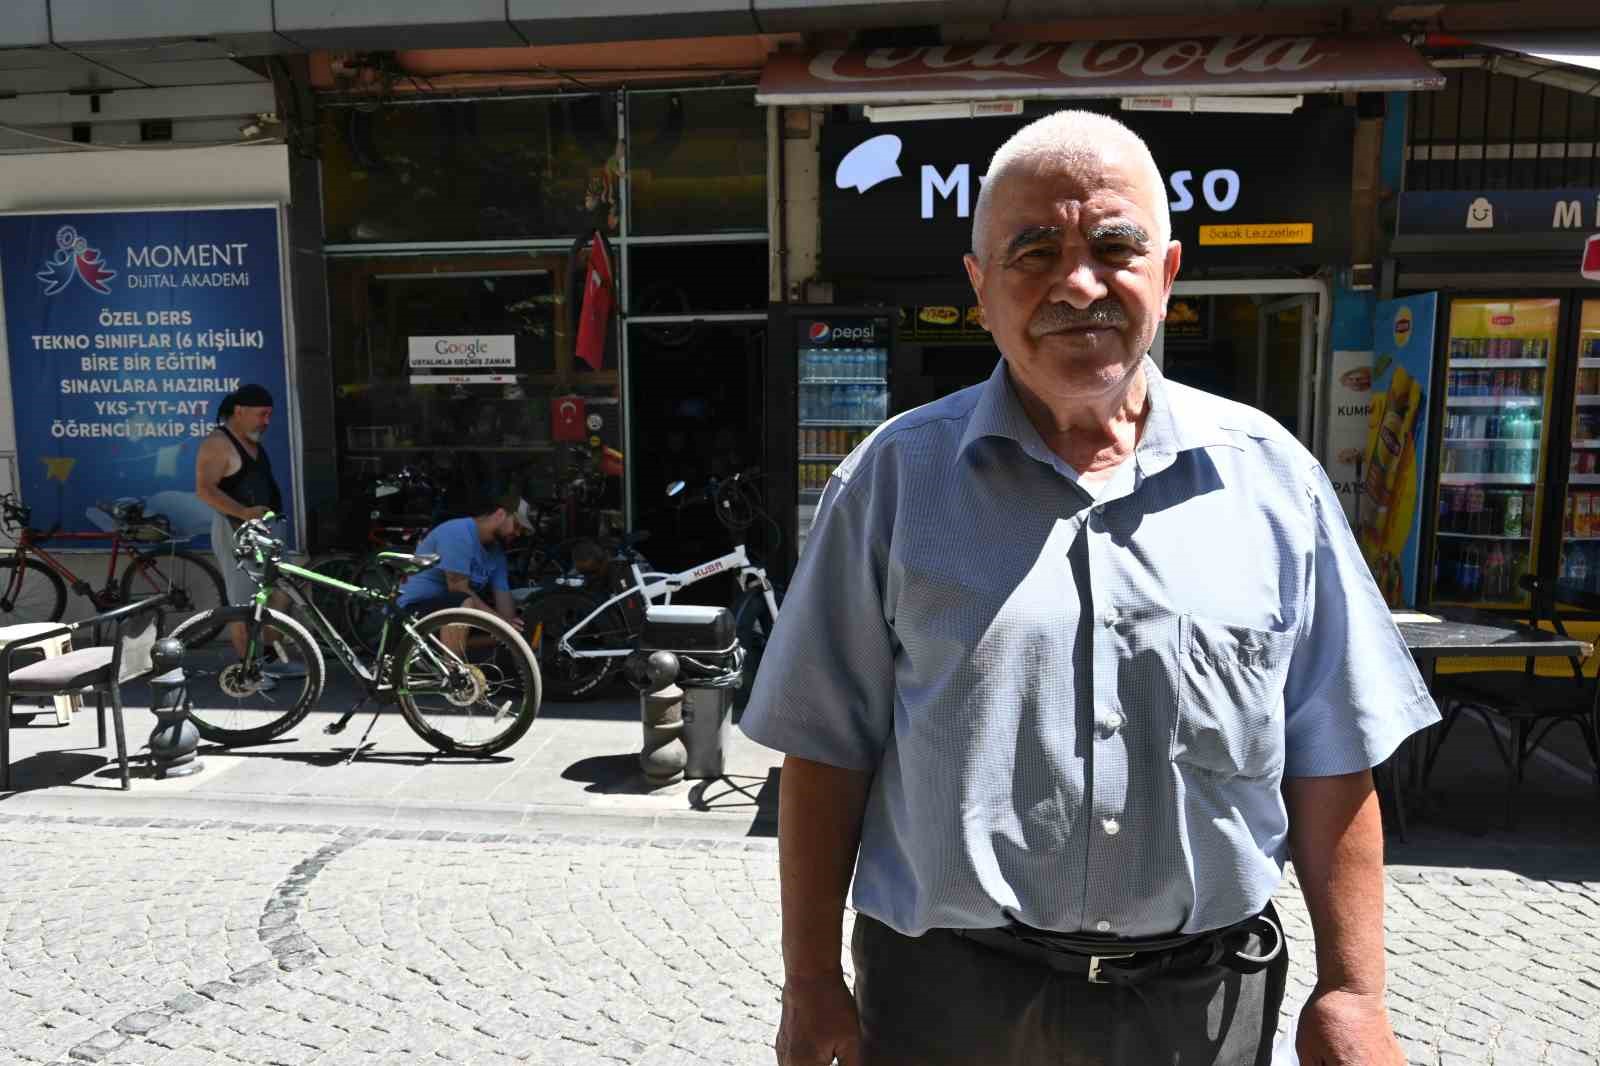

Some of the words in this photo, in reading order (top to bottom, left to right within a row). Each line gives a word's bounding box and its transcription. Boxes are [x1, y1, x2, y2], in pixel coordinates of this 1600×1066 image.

[127, 243, 249, 268] MOMENT
[98, 308, 143, 327] ÖZEL
[146, 310, 192, 325] DERS
[32, 335, 90, 350] TEKNO
[95, 333, 171, 349] SINIFLAR
[176, 332, 191, 349] (6
[197, 329, 265, 349] KİŞİLİK)
[832, 323, 875, 341] pepsi
[435, 338, 488, 358] Google
[81, 353, 119, 371] BİRE
[124, 352, 151, 371] BİR
[156, 351, 217, 371] EĞİTİM
[60, 378, 158, 394] SINAVLARA
[163, 377, 241, 393] HAZIRLIK
[95, 400, 209, 416] YKS-TYT-AYT
[51, 418, 130, 437] ÖĞRENCİ
[136, 419, 185, 437] TAKİP
